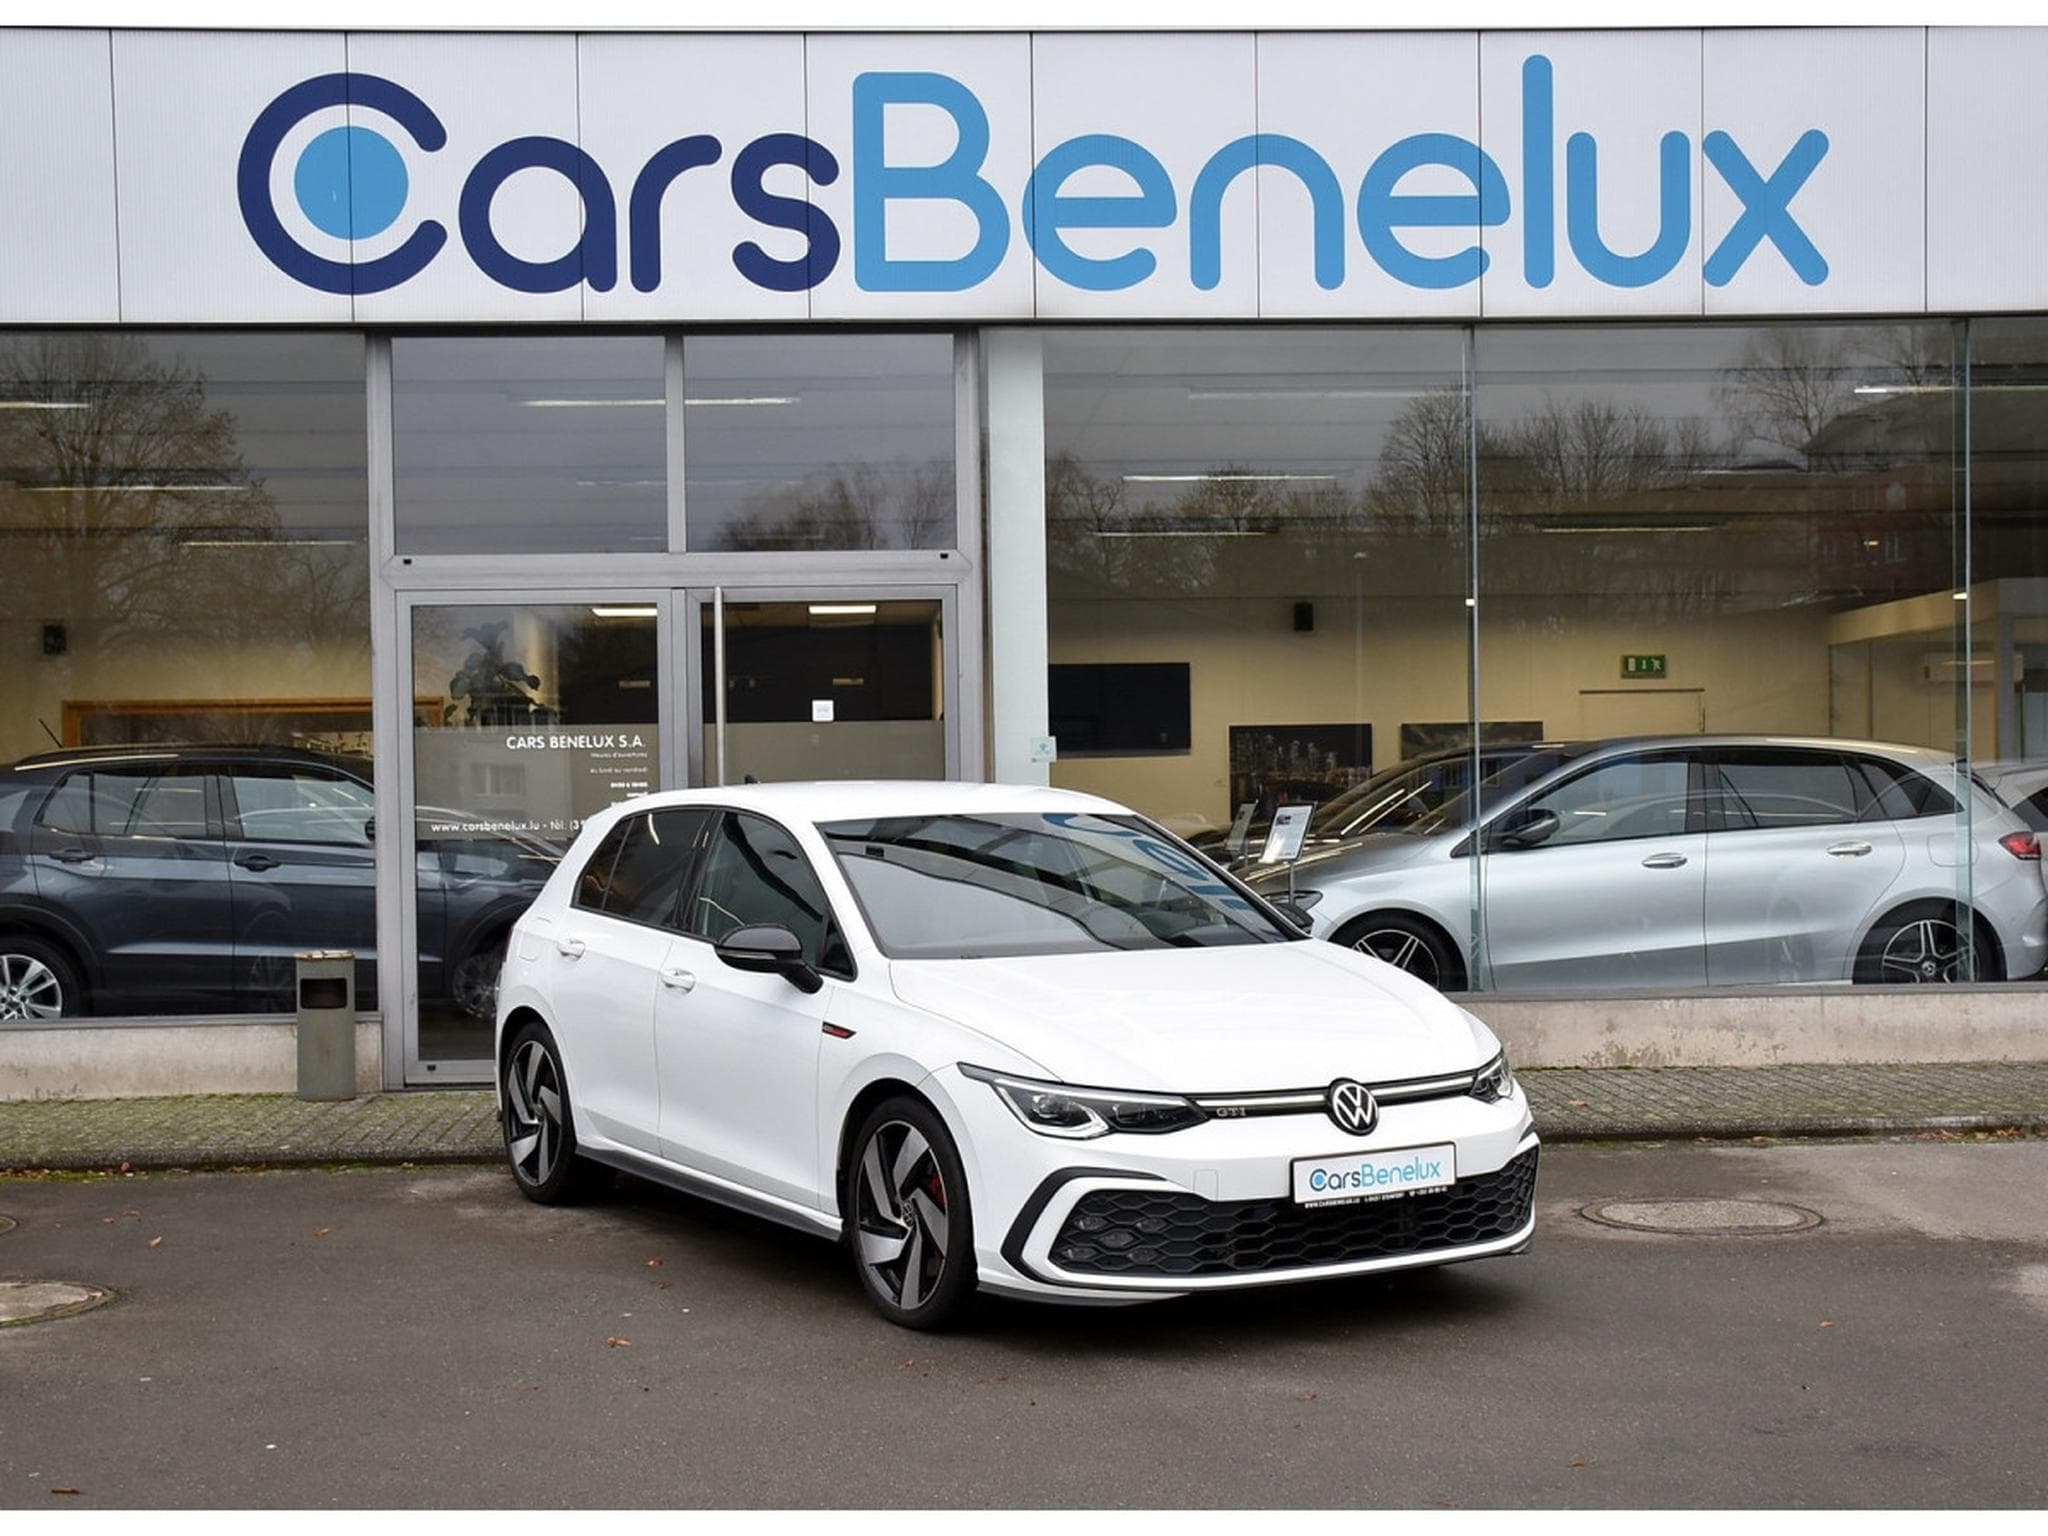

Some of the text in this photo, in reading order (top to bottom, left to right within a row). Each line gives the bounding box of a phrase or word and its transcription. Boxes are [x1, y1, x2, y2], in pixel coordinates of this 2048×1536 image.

[237, 53, 1831, 295] CarsBenelux
[506, 734, 646, 749] CARS BENELUX S.A.
[1216, 1107, 1246, 1117] GTI
[1309, 1156, 1440, 1192] CarsBenelux
